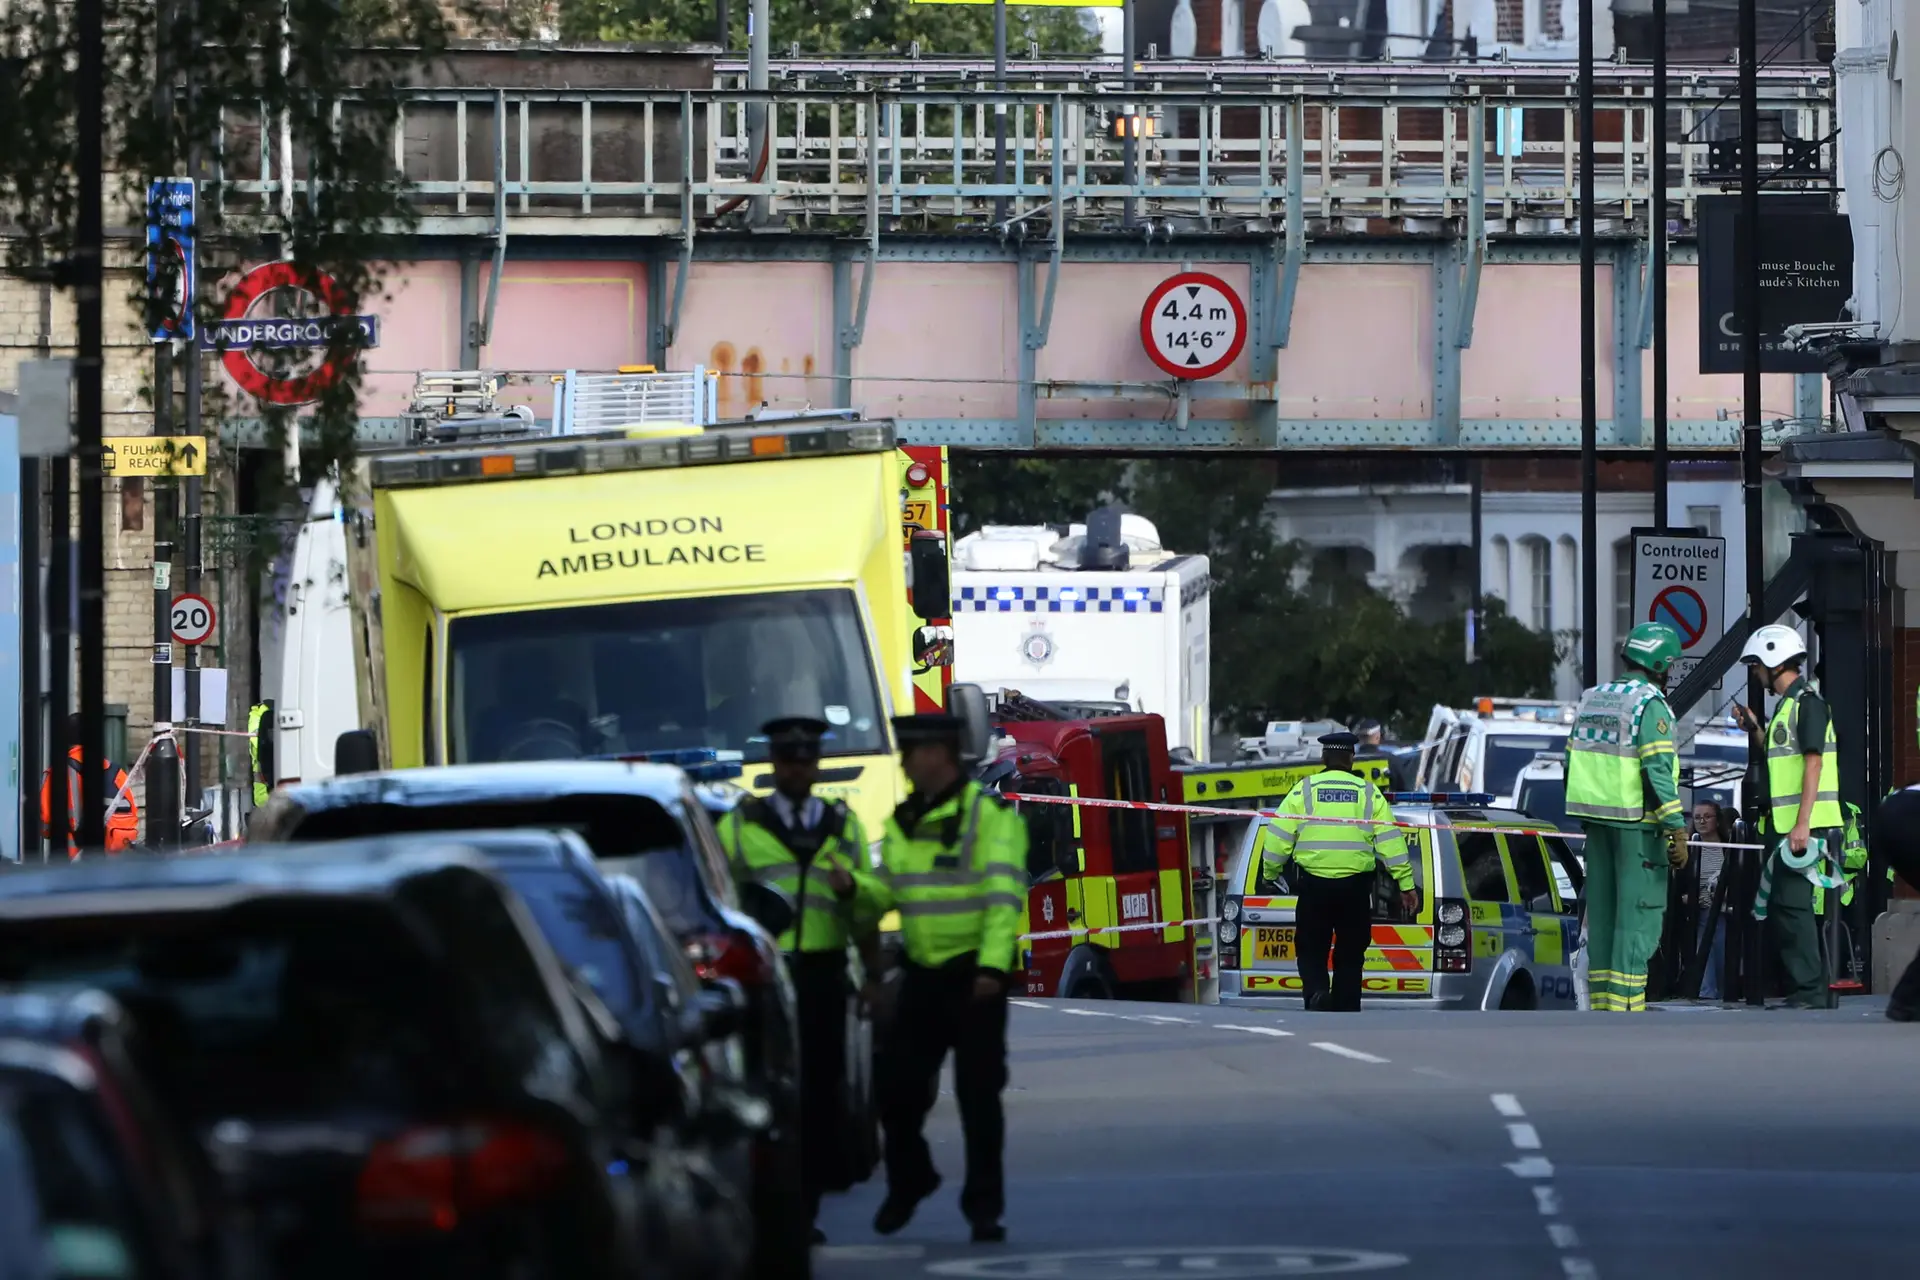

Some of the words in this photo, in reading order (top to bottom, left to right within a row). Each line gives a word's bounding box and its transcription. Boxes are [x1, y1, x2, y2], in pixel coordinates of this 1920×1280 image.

[1758, 261, 1790, 270] muse
[1794, 261, 1836, 270] Bouche
[1759, 277, 1793, 287] aude's
[1797, 277, 1840, 287] Kitchen
[1162, 300, 1203, 320] 4.4
[1210, 307, 1227, 320] m
[129, 458, 168, 468] REACH
[903, 503, 927, 520] 57
[569, 516, 723, 544] LONDON
[1642, 543, 1719, 559] Controlled
[536, 544, 766, 579] AMBULANCE
[1652, 564, 1708, 581] ZONE
[172, 608, 207, 630] 20
[1318, 793, 1357, 802] POLICE
[1124, 897, 1147, 914] LFB
[1258, 929, 1294, 943] BX66
[1263, 945, 1288, 958] AWR
[1247, 976, 1425, 991] POCE
